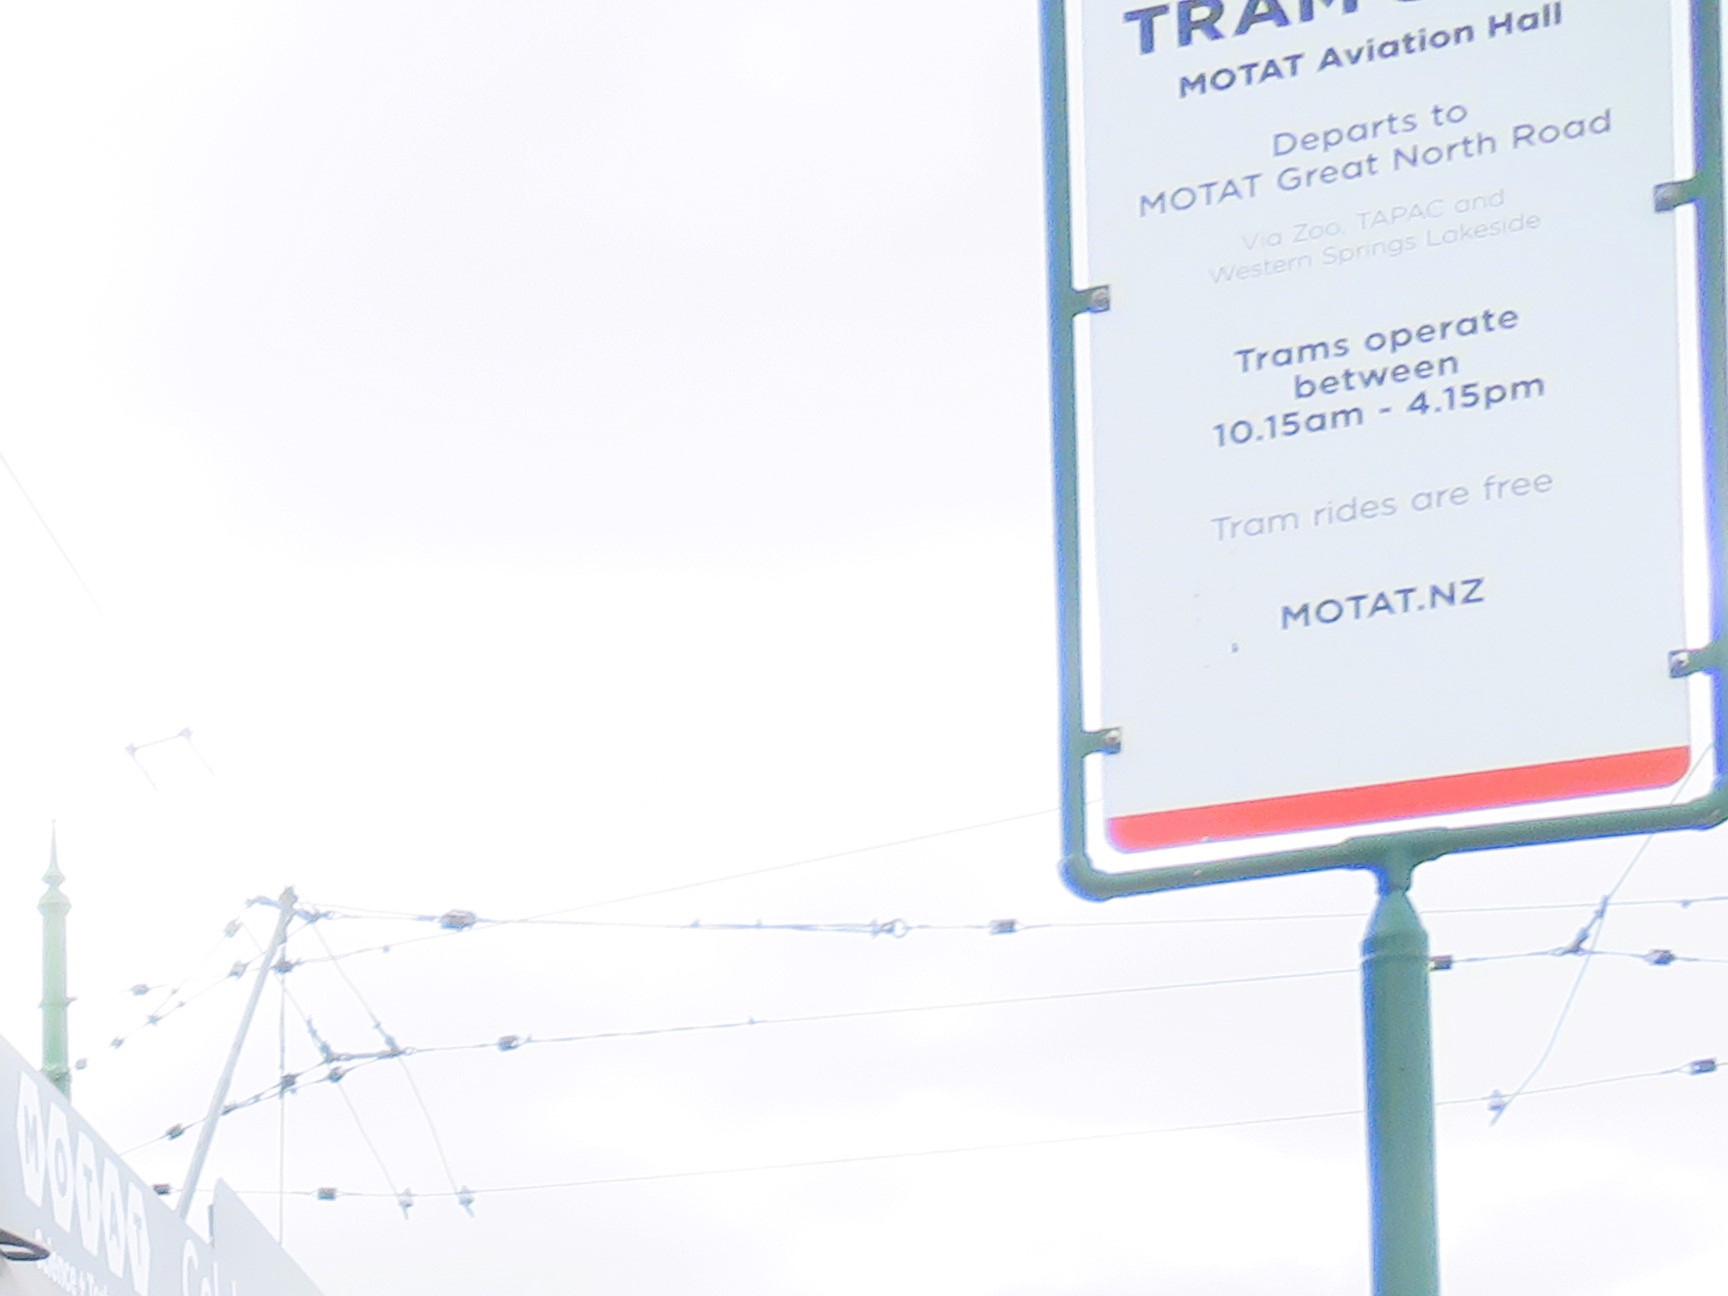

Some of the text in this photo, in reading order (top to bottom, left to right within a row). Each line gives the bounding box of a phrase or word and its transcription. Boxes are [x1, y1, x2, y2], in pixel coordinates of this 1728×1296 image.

[1179, 2, 1562, 98] MOTAT Aviation Hall
[1138, 109, 1613, 216] MOTAT Great North Road
[1272, 102, 1468, 157] Departs to
[1209, 210, 1541, 284] Western Springs Lakeside
[1241, 228, 1284, 252] Via
[1357, 199, 1445, 231] TAPAC
[1454, 189, 1505, 217] and
[1234, 307, 1519, 375] Trams operate
[1213, 375, 1544, 448] 10.15am - 4.15pm
[1294, 353, 1459, 401] between
[1211, 471, 1553, 543] Tram rides are free
[1280, 576, 1485, 631] MOTAT.NZ
